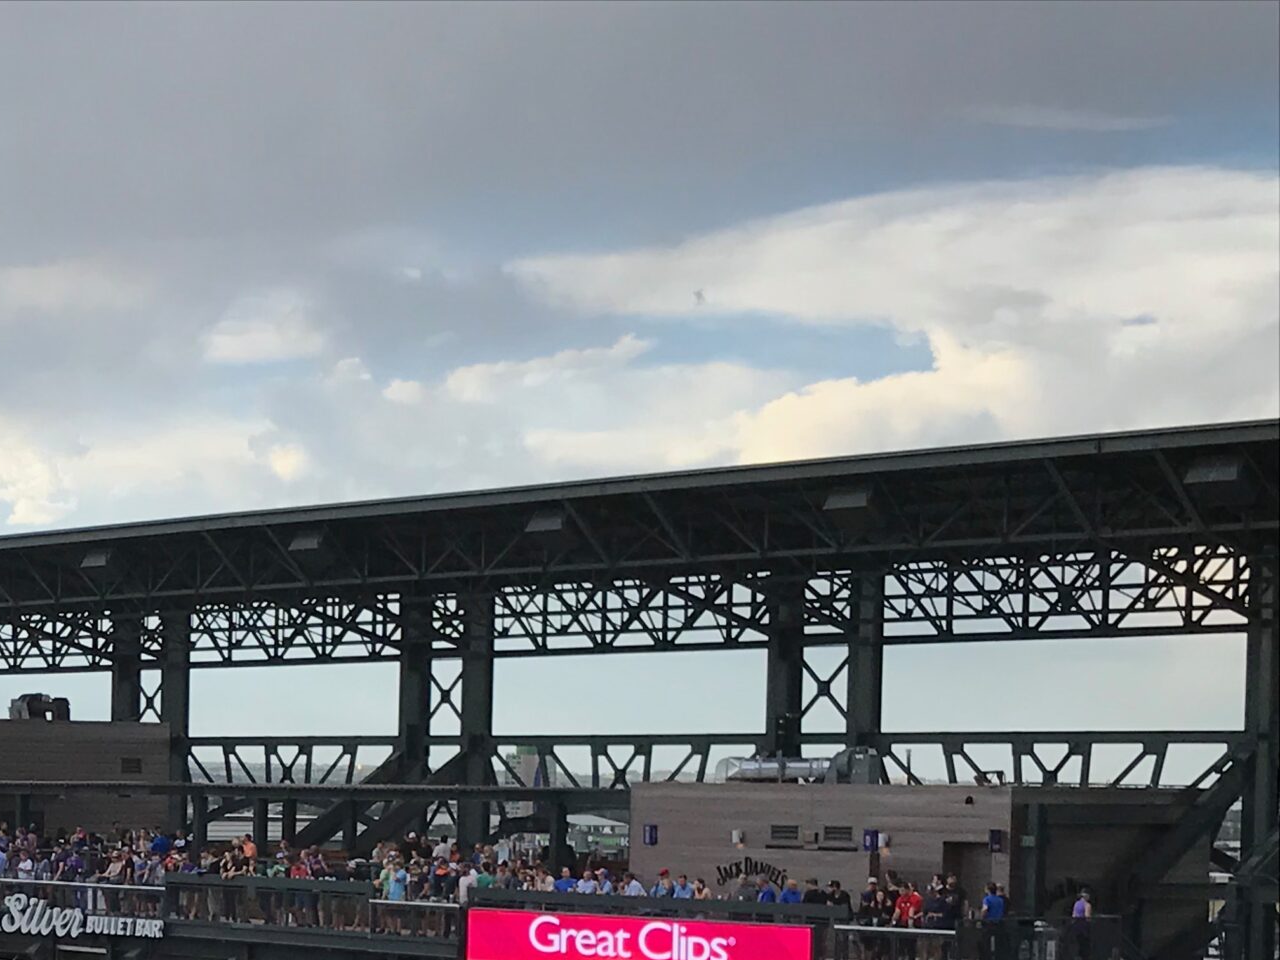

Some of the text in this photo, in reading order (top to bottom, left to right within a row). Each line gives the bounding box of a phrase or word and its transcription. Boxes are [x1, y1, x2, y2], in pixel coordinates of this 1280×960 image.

[716, 860, 743, 886] JACK
[1, 893, 84, 938] Silver
[86, 915, 133, 937] BULLET
[528, 915, 631, 959] Great
